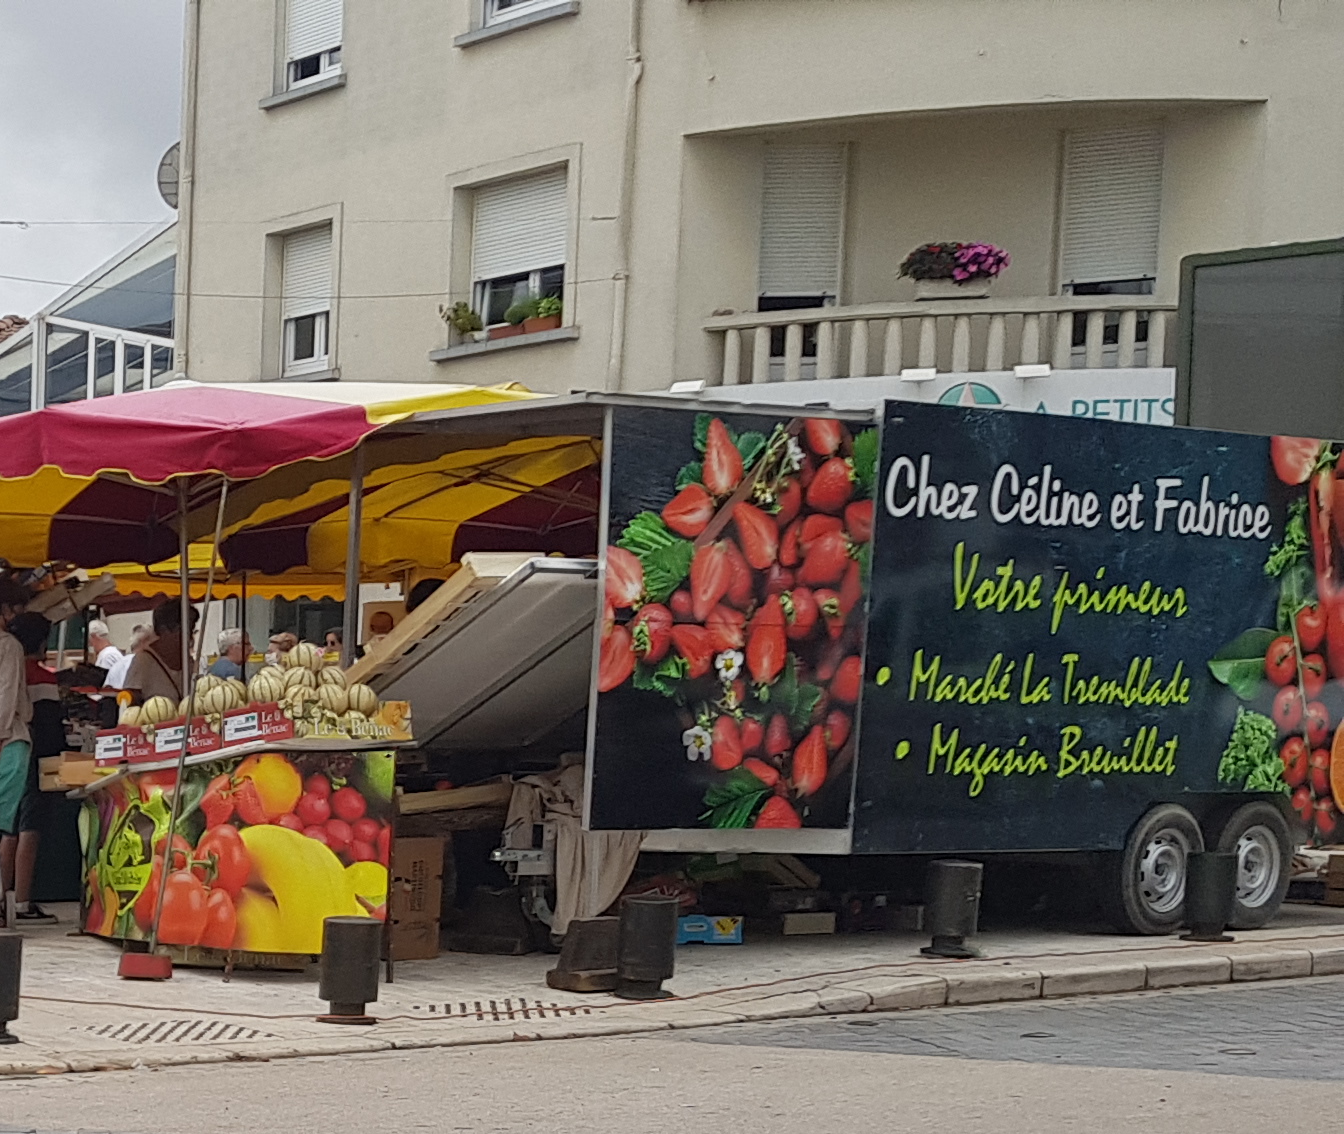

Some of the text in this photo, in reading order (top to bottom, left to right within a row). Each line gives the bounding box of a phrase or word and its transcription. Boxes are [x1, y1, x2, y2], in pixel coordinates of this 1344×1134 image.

[885, 454, 1272, 540] Chez Céline et Fabrice
[953, 541, 1188, 635] Votre primeur
[909, 649, 1190, 708] Marché La Tremblade
[927, 723, 1178, 797] Magasin Breuillet
